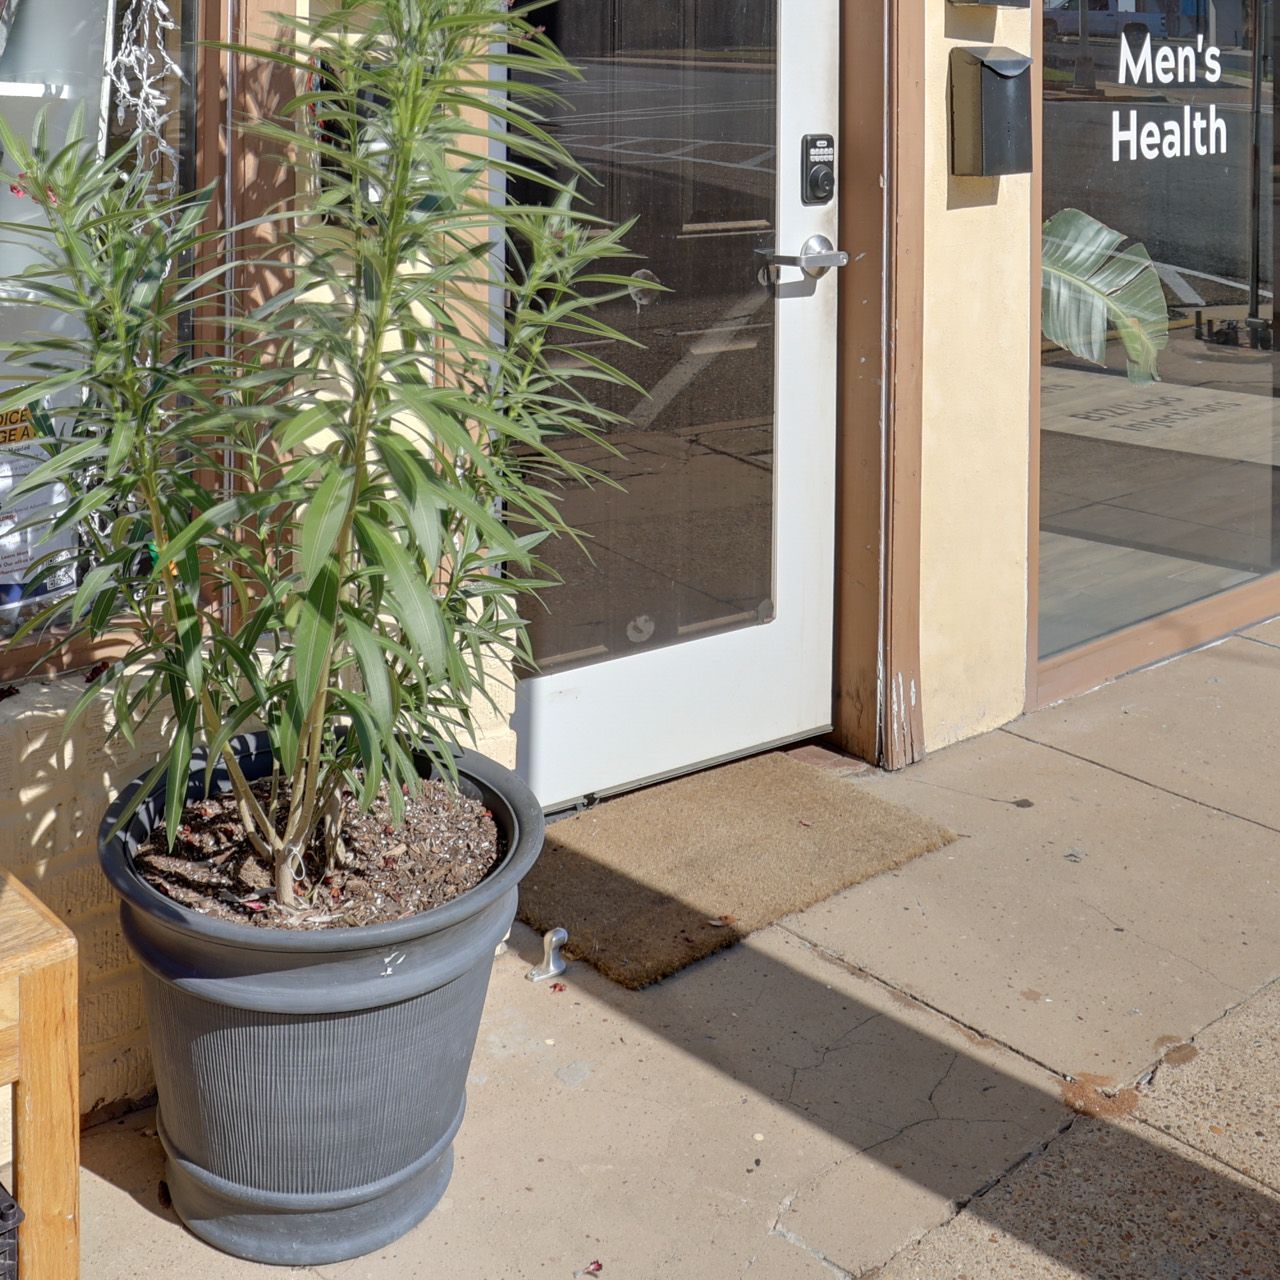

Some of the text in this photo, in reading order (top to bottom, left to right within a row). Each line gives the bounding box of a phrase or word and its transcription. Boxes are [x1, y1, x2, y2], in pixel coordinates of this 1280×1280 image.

[1118, 31, 1221, 85] Men's
[1112, 104, 1227, 162] Health
[20, 427, 30, 439] A
